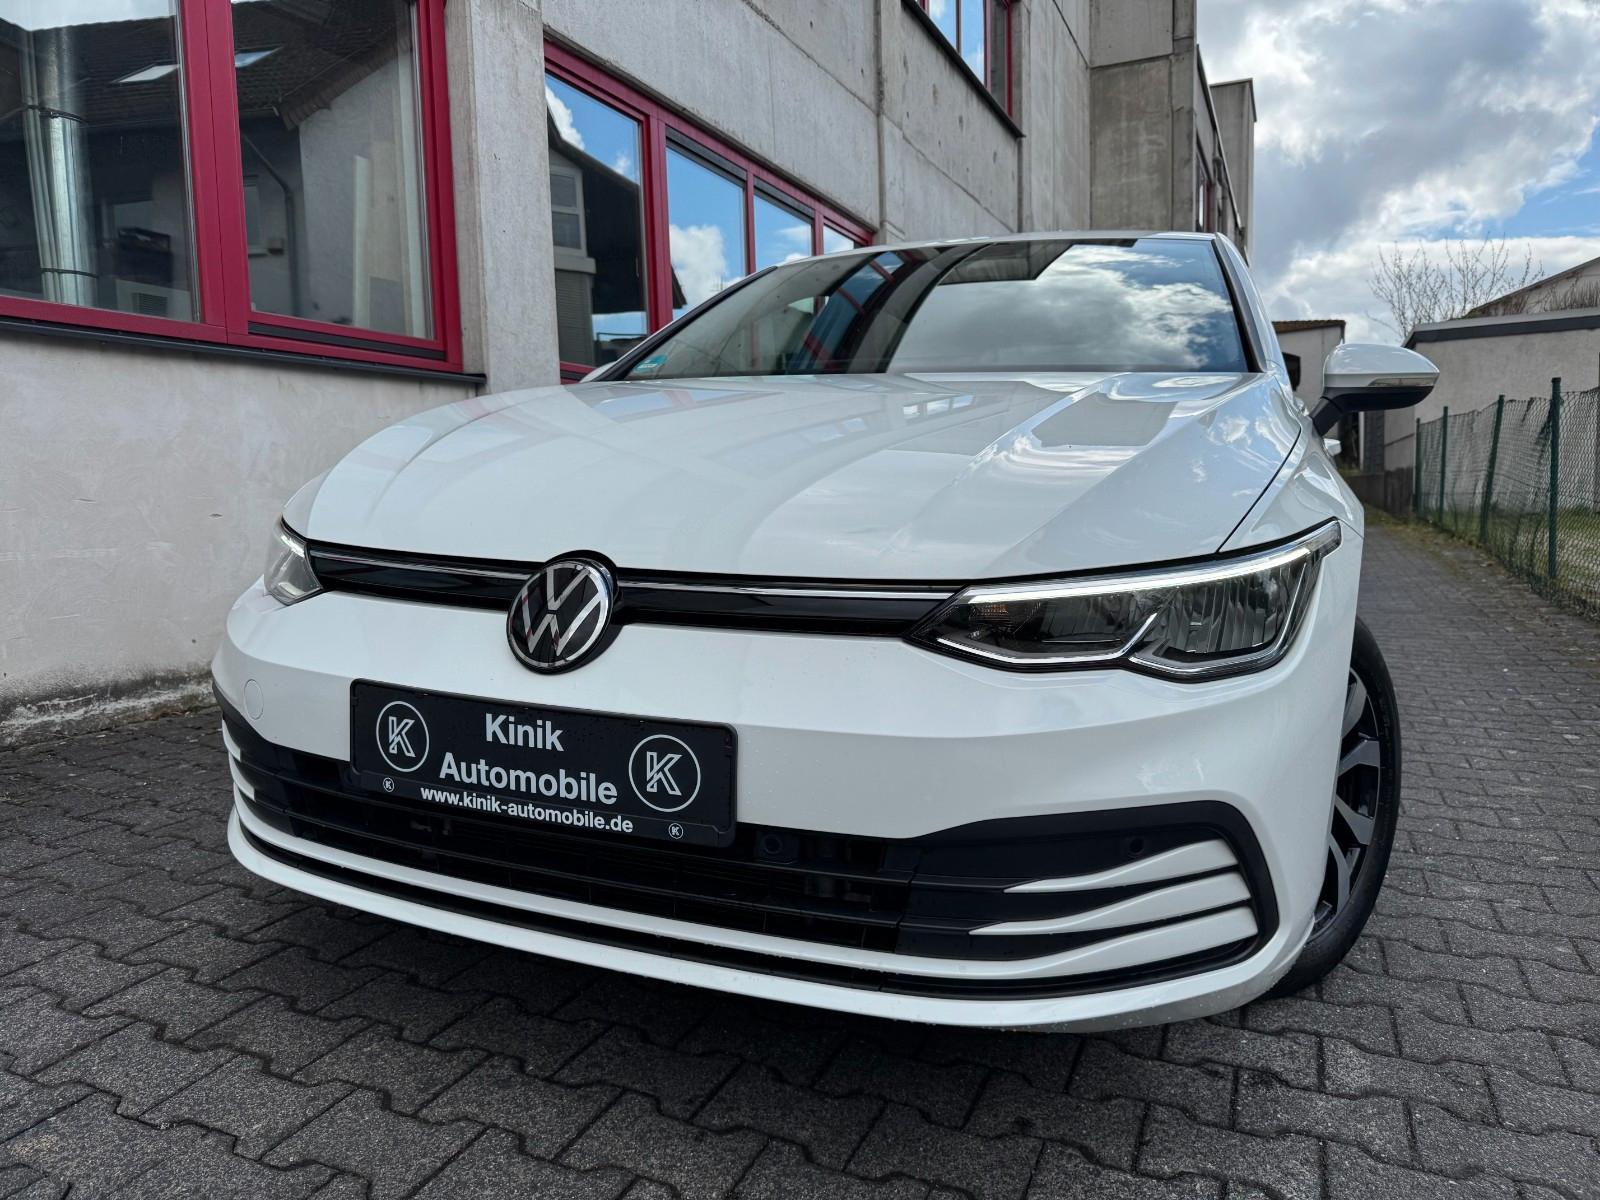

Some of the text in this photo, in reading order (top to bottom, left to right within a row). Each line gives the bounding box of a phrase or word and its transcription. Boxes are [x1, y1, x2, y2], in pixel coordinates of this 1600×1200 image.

[388, 715, 416, 758] K
[485, 713, 564, 752] Kinik
[440, 752, 618, 804] Automobile
[646, 751, 682, 797] K
[420, 787, 634, 833] www.kinik-automobile.de
